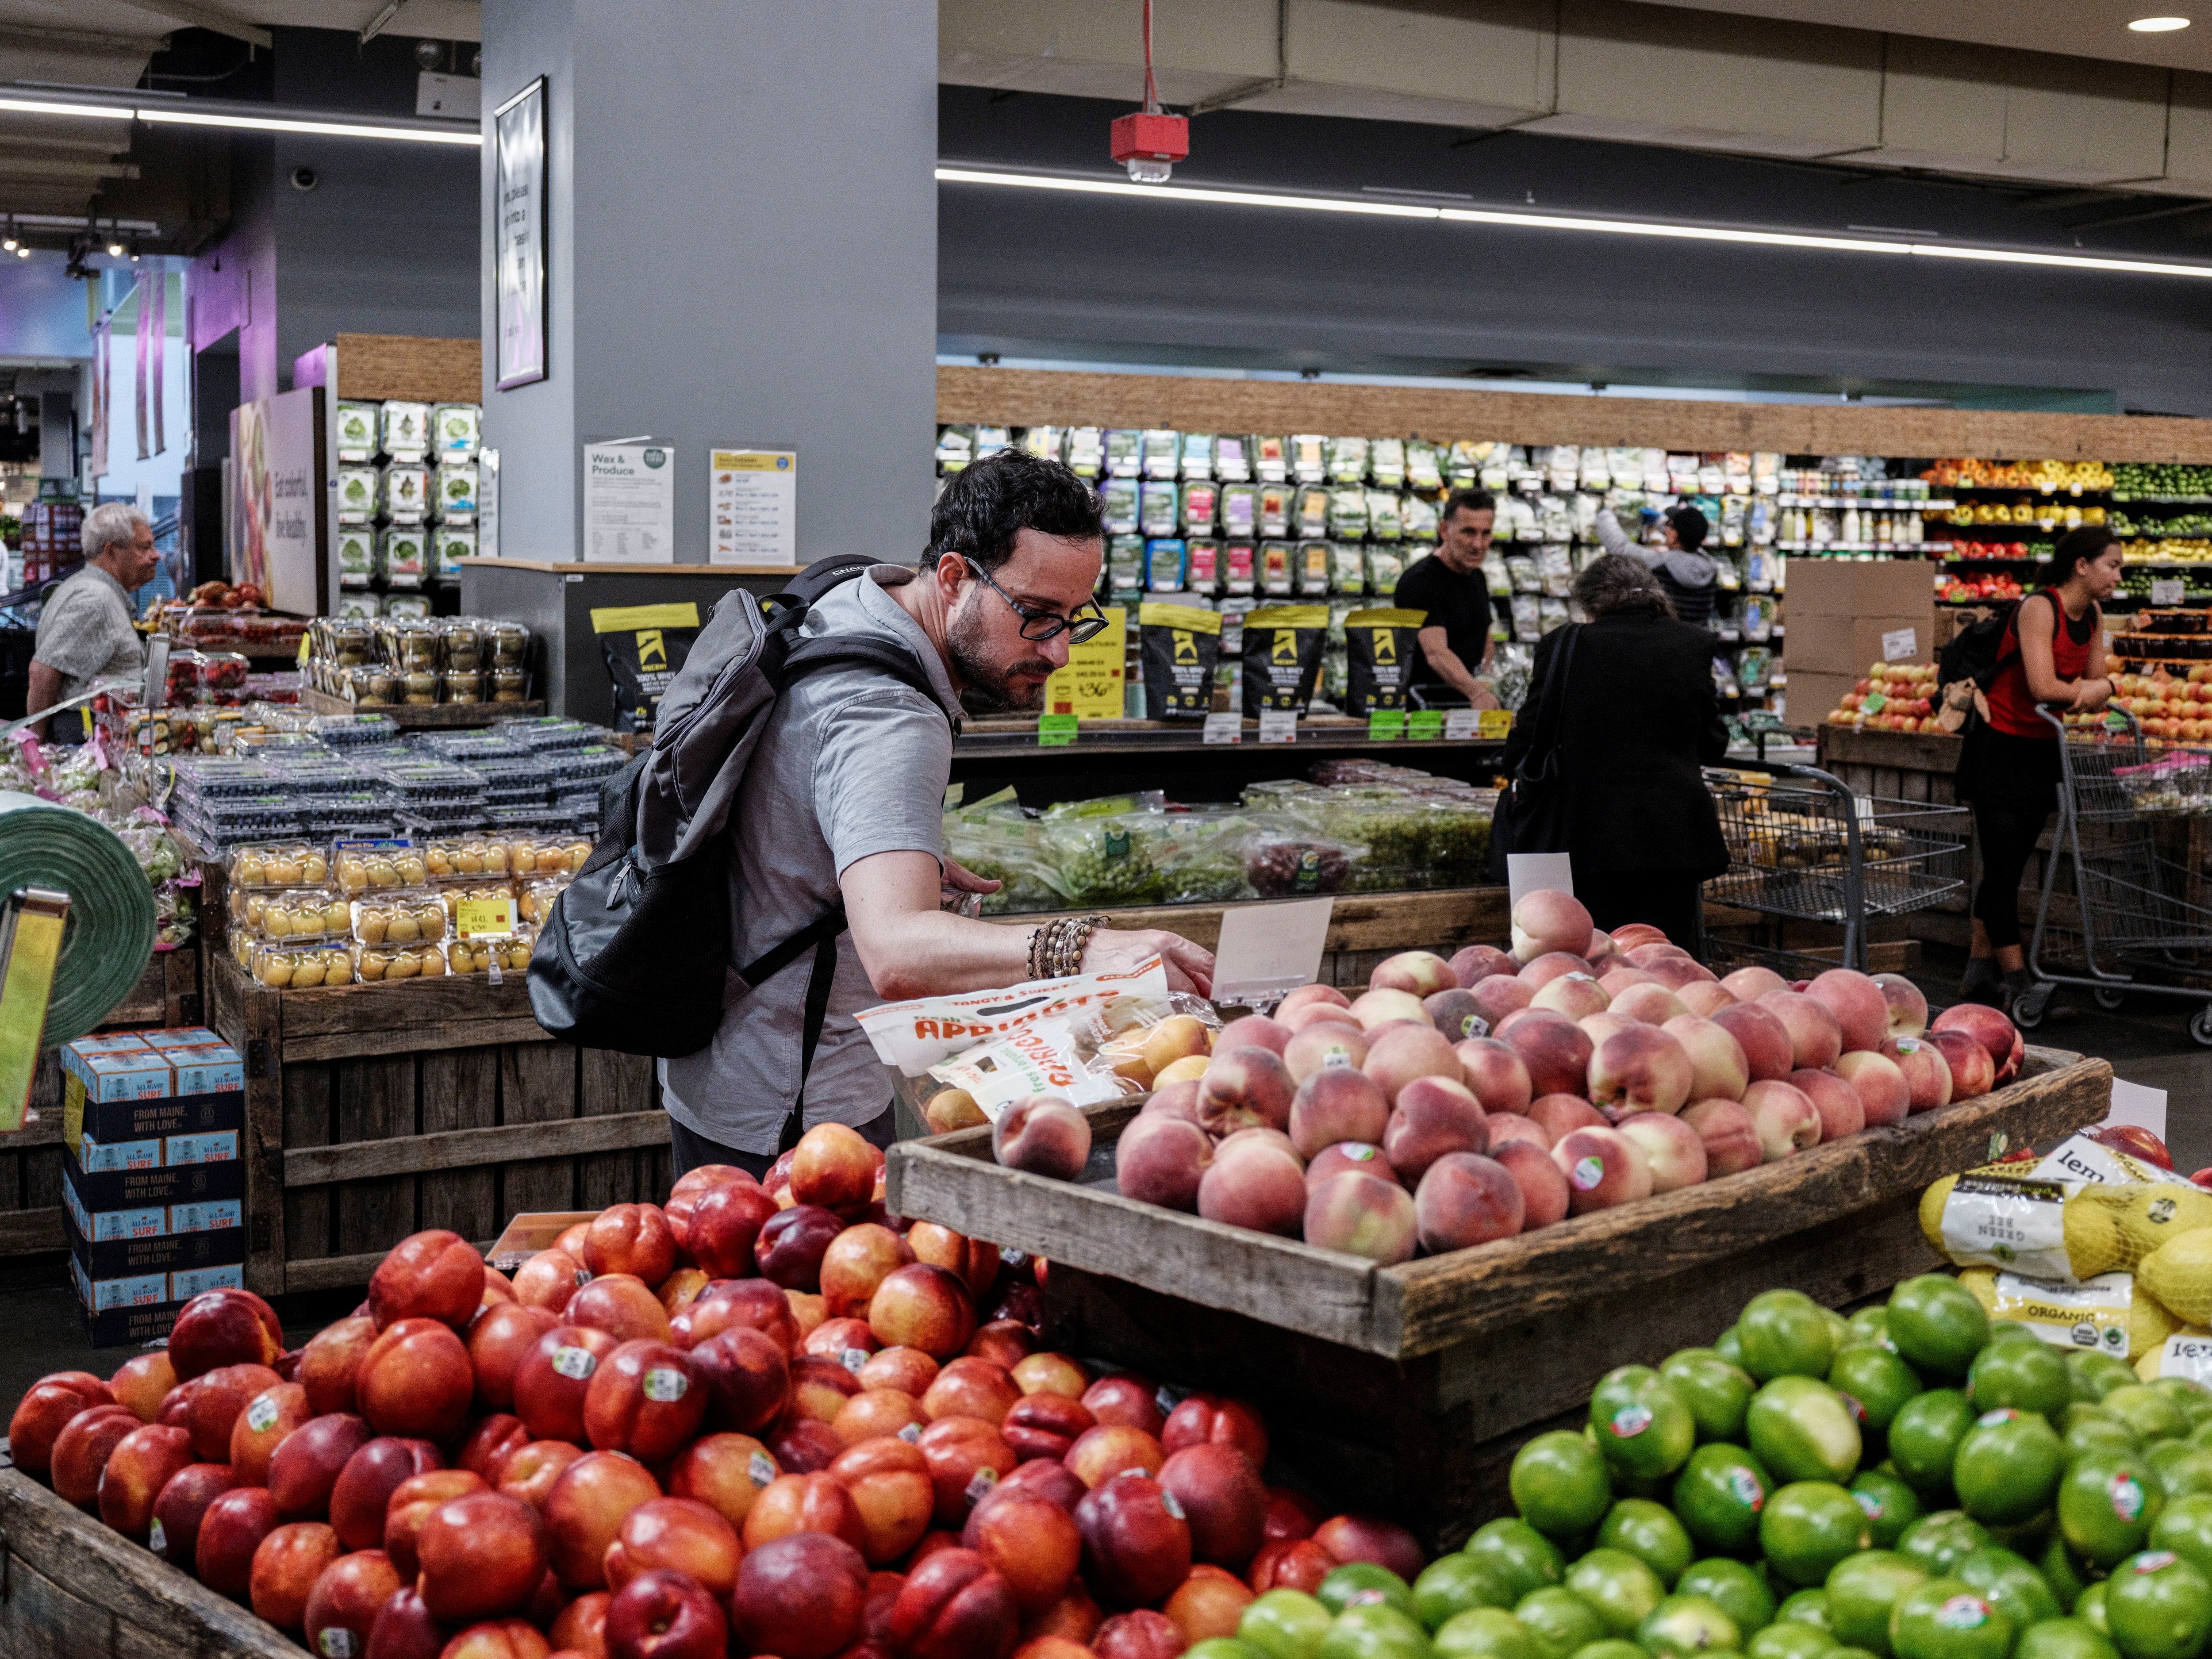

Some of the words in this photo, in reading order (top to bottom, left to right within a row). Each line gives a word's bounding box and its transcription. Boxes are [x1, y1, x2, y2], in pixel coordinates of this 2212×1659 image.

[593, 454, 614, 463] Wax
[618, 455, 625, 464] &
[593, 466, 634, 475] Produce
[832, 566, 869, 575] CHAR
[636, 673, 657, 683] 100%
[657, 672, 676, 682] WHEY
[952, 996, 999, 1006] TANGY
[1019, 983, 1069, 996] SWEET
[215, 1083, 240, 1093] SURF
[138, 1090, 163, 1100] SURF
[134, 1109, 157, 1120] FROM
[134, 1121, 155, 1132] WITH
[204, 1152, 230, 1162] SURF
[127, 1160, 153, 1169] SURF
[125, 1176, 148, 1187] FROM
[125, 1188, 146, 1199] WITH
[209, 1217, 234, 1229] SURF
[1988, 1215, 2013, 1227] BEE
[132, 1225, 158, 1237] SURF
[1978, 1225, 2024, 1242] GREEN
[128, 1244, 151, 1255] FROM
[128, 1255, 150, 1266] WITH
[210, 1278, 236, 1286] ALLAGASH
[133, 1294, 158, 1305] SURF
[2028, 1306, 2097, 1322] ORGANIC
[129, 1315, 152, 1326] FROM
[129, 1327, 150, 1337] WITH
